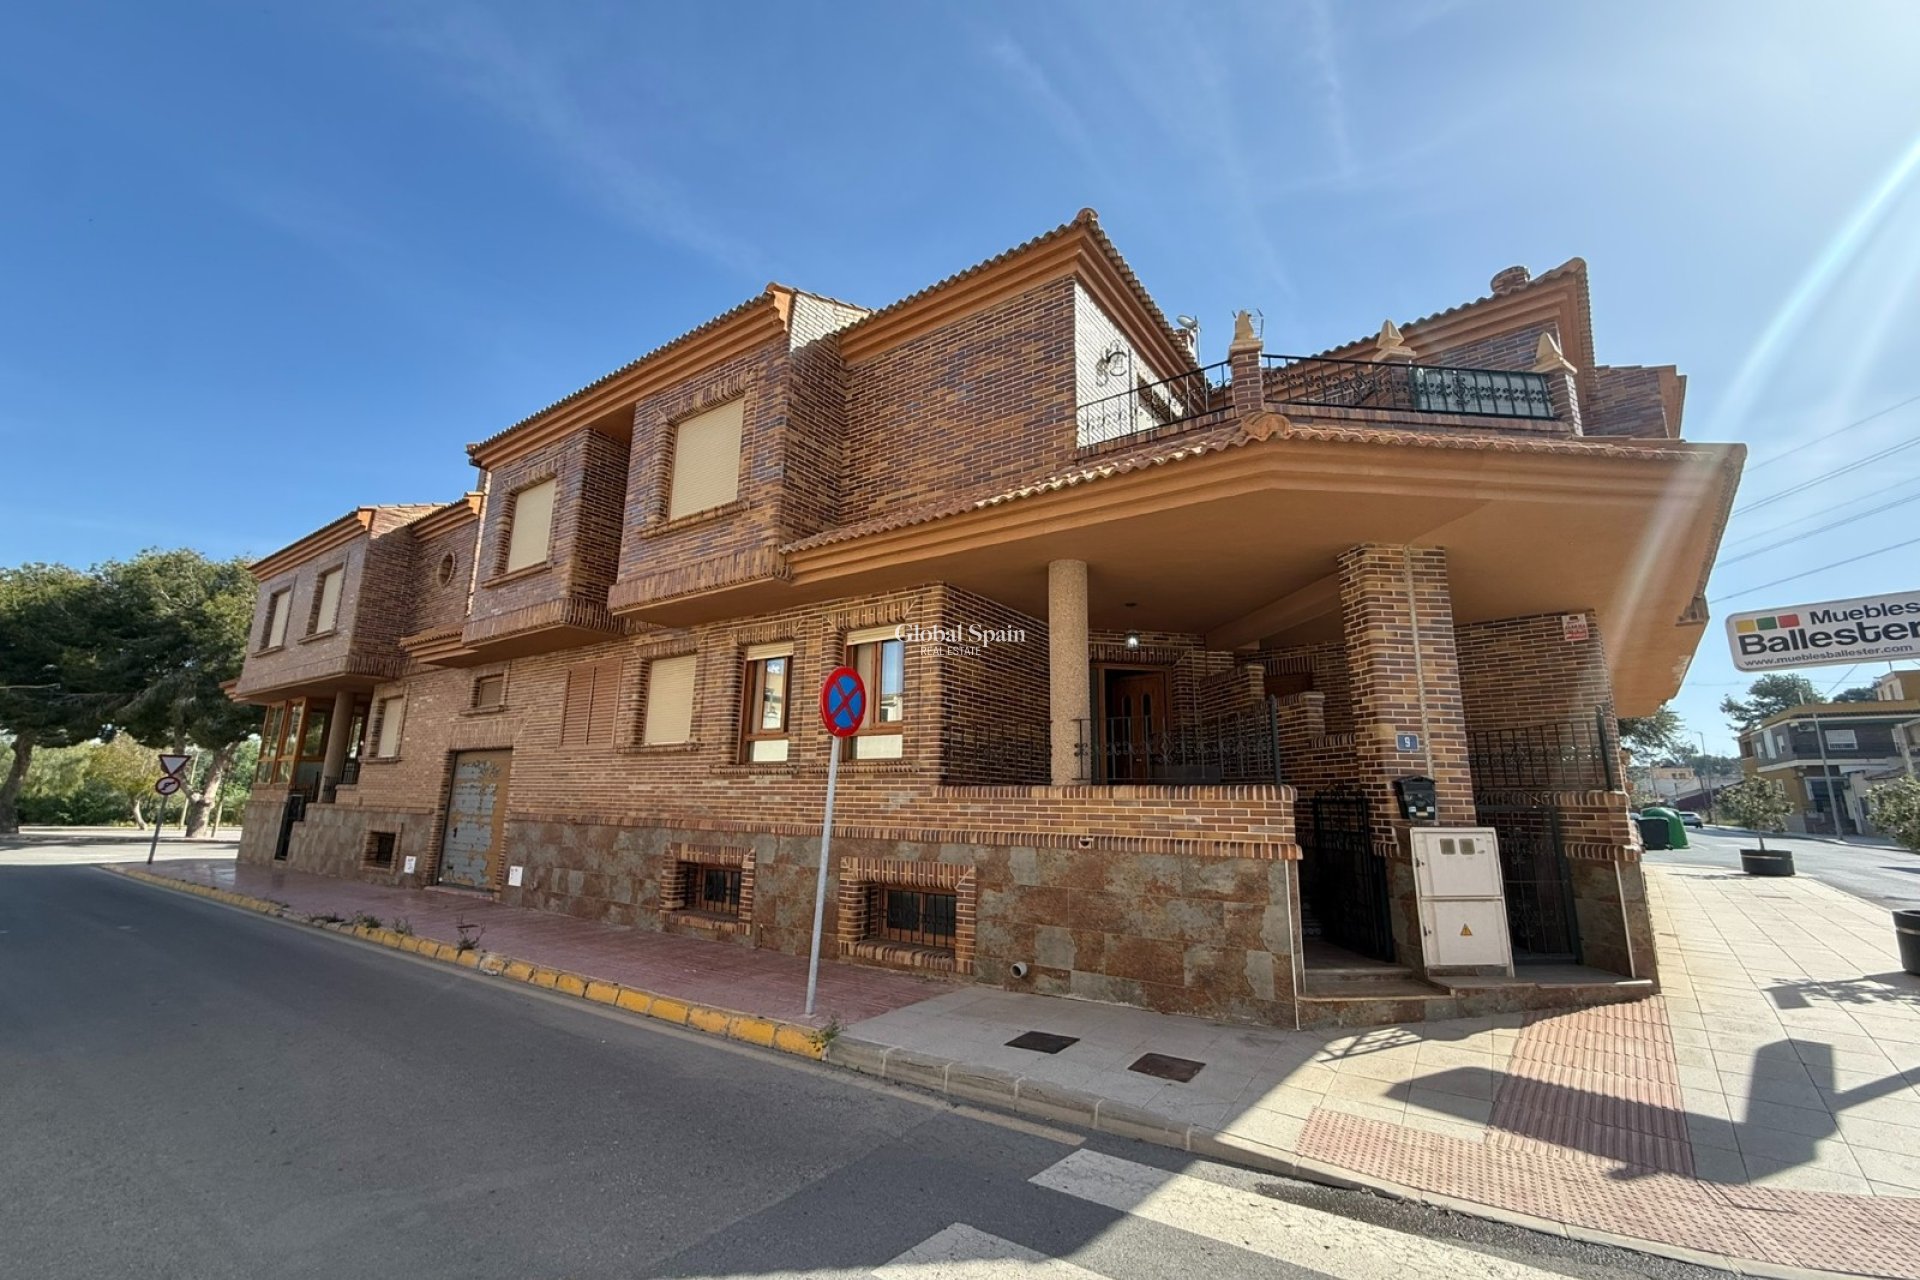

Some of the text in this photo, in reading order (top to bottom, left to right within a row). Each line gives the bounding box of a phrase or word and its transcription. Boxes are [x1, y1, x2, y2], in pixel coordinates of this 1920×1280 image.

[1810, 602, 1920, 625] Muebles
[1744, 645, 1914, 666] www.mueblesballester.com
[1404, 736, 1411, 748] 9
